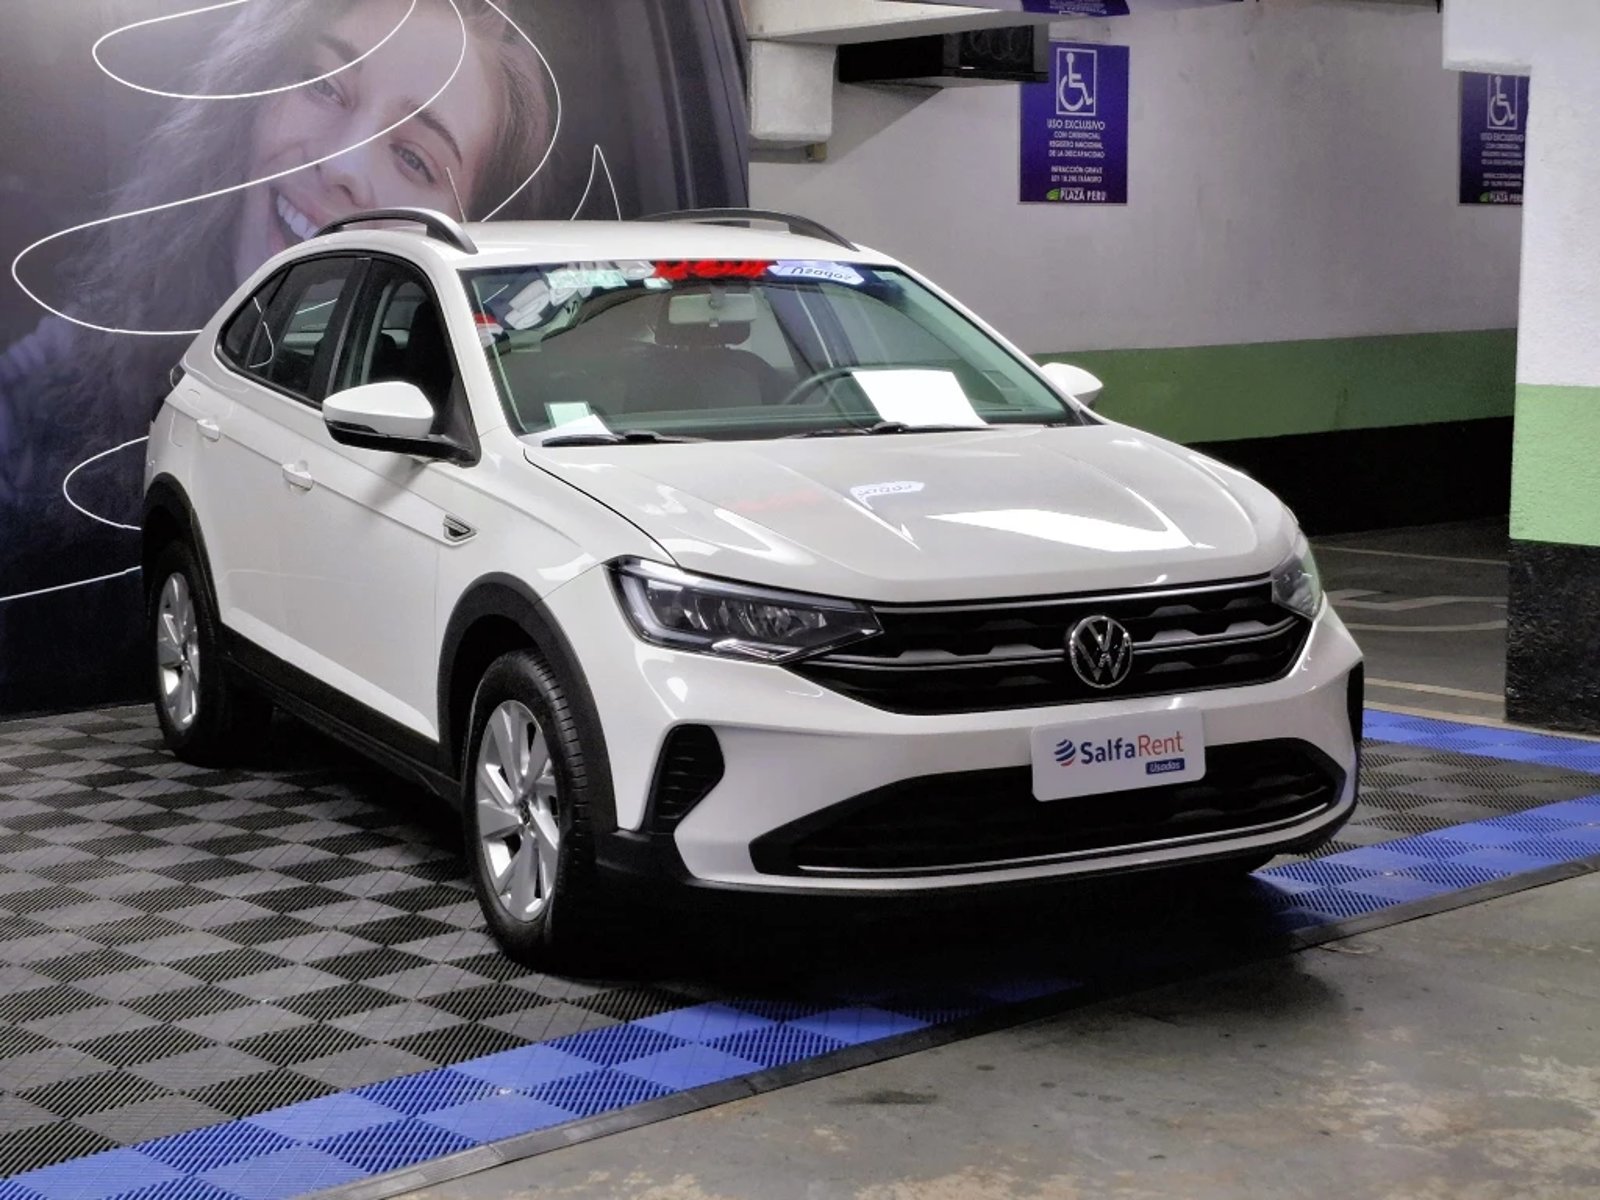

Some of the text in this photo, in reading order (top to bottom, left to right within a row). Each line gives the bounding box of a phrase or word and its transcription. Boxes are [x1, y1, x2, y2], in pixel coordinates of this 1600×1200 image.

[1065, 119, 1106, 130] EXCLUSIVO
[1060, 189, 1085, 201] PLAZA
[1080, 731, 1184, 765] SalfaRent
[1150, 761, 1181, 773] Usados
